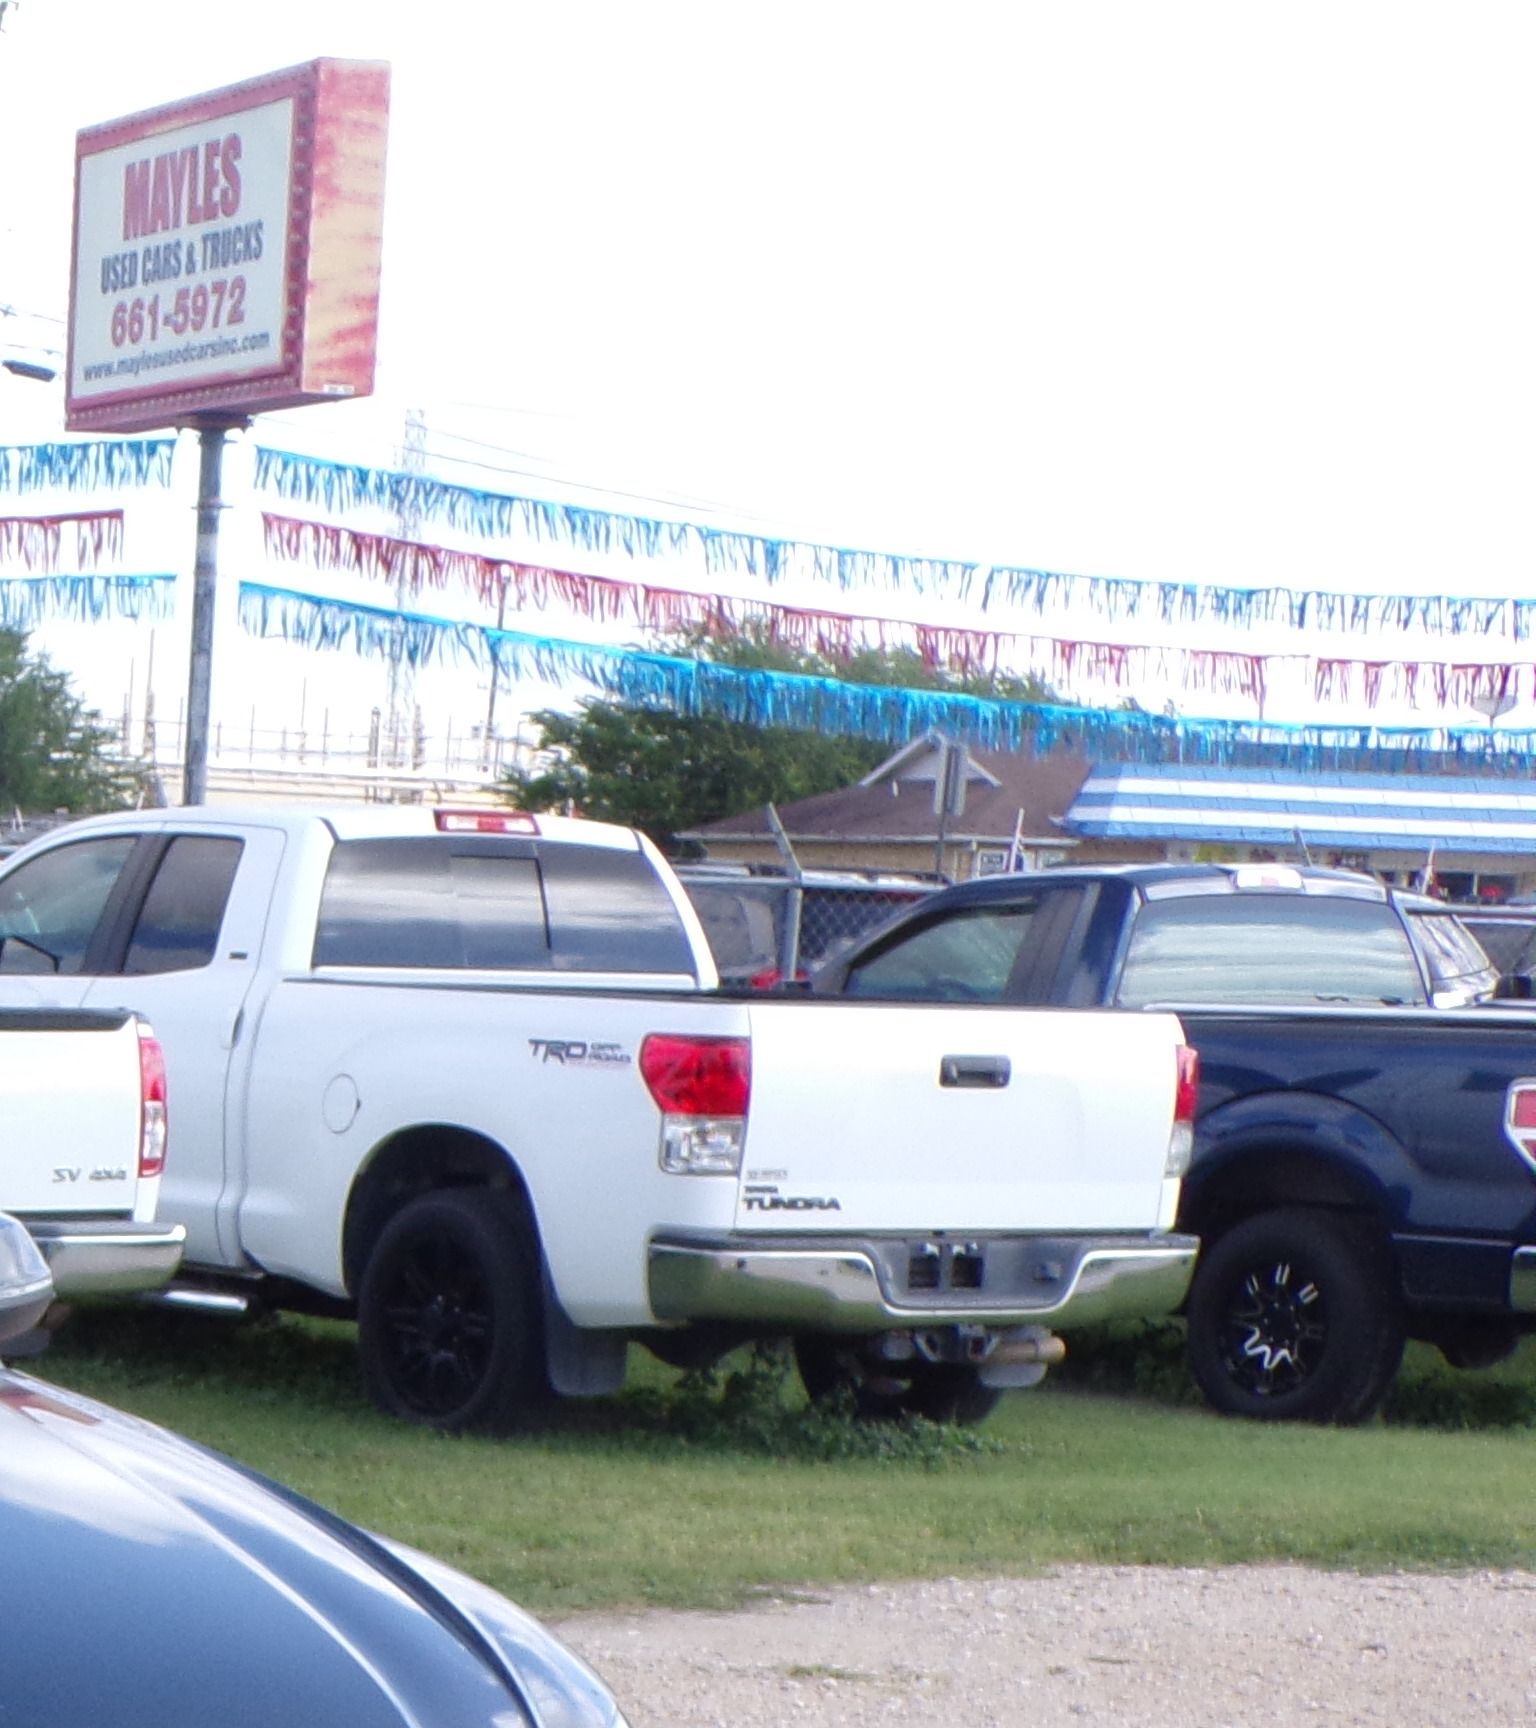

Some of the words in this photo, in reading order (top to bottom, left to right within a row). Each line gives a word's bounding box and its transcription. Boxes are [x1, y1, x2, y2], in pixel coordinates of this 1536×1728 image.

[123, 133, 242, 240] MAYLES
[101, 252, 137, 294] USED
[141, 238, 182, 286] CARS
[186, 241, 196, 276] &
[201, 219, 264, 271] TRUCKS
[111, 275, 247, 347] 661-5972
[52, 1167, 81, 1183] SV
[743, 1198, 840, 1211] TUNDRA
